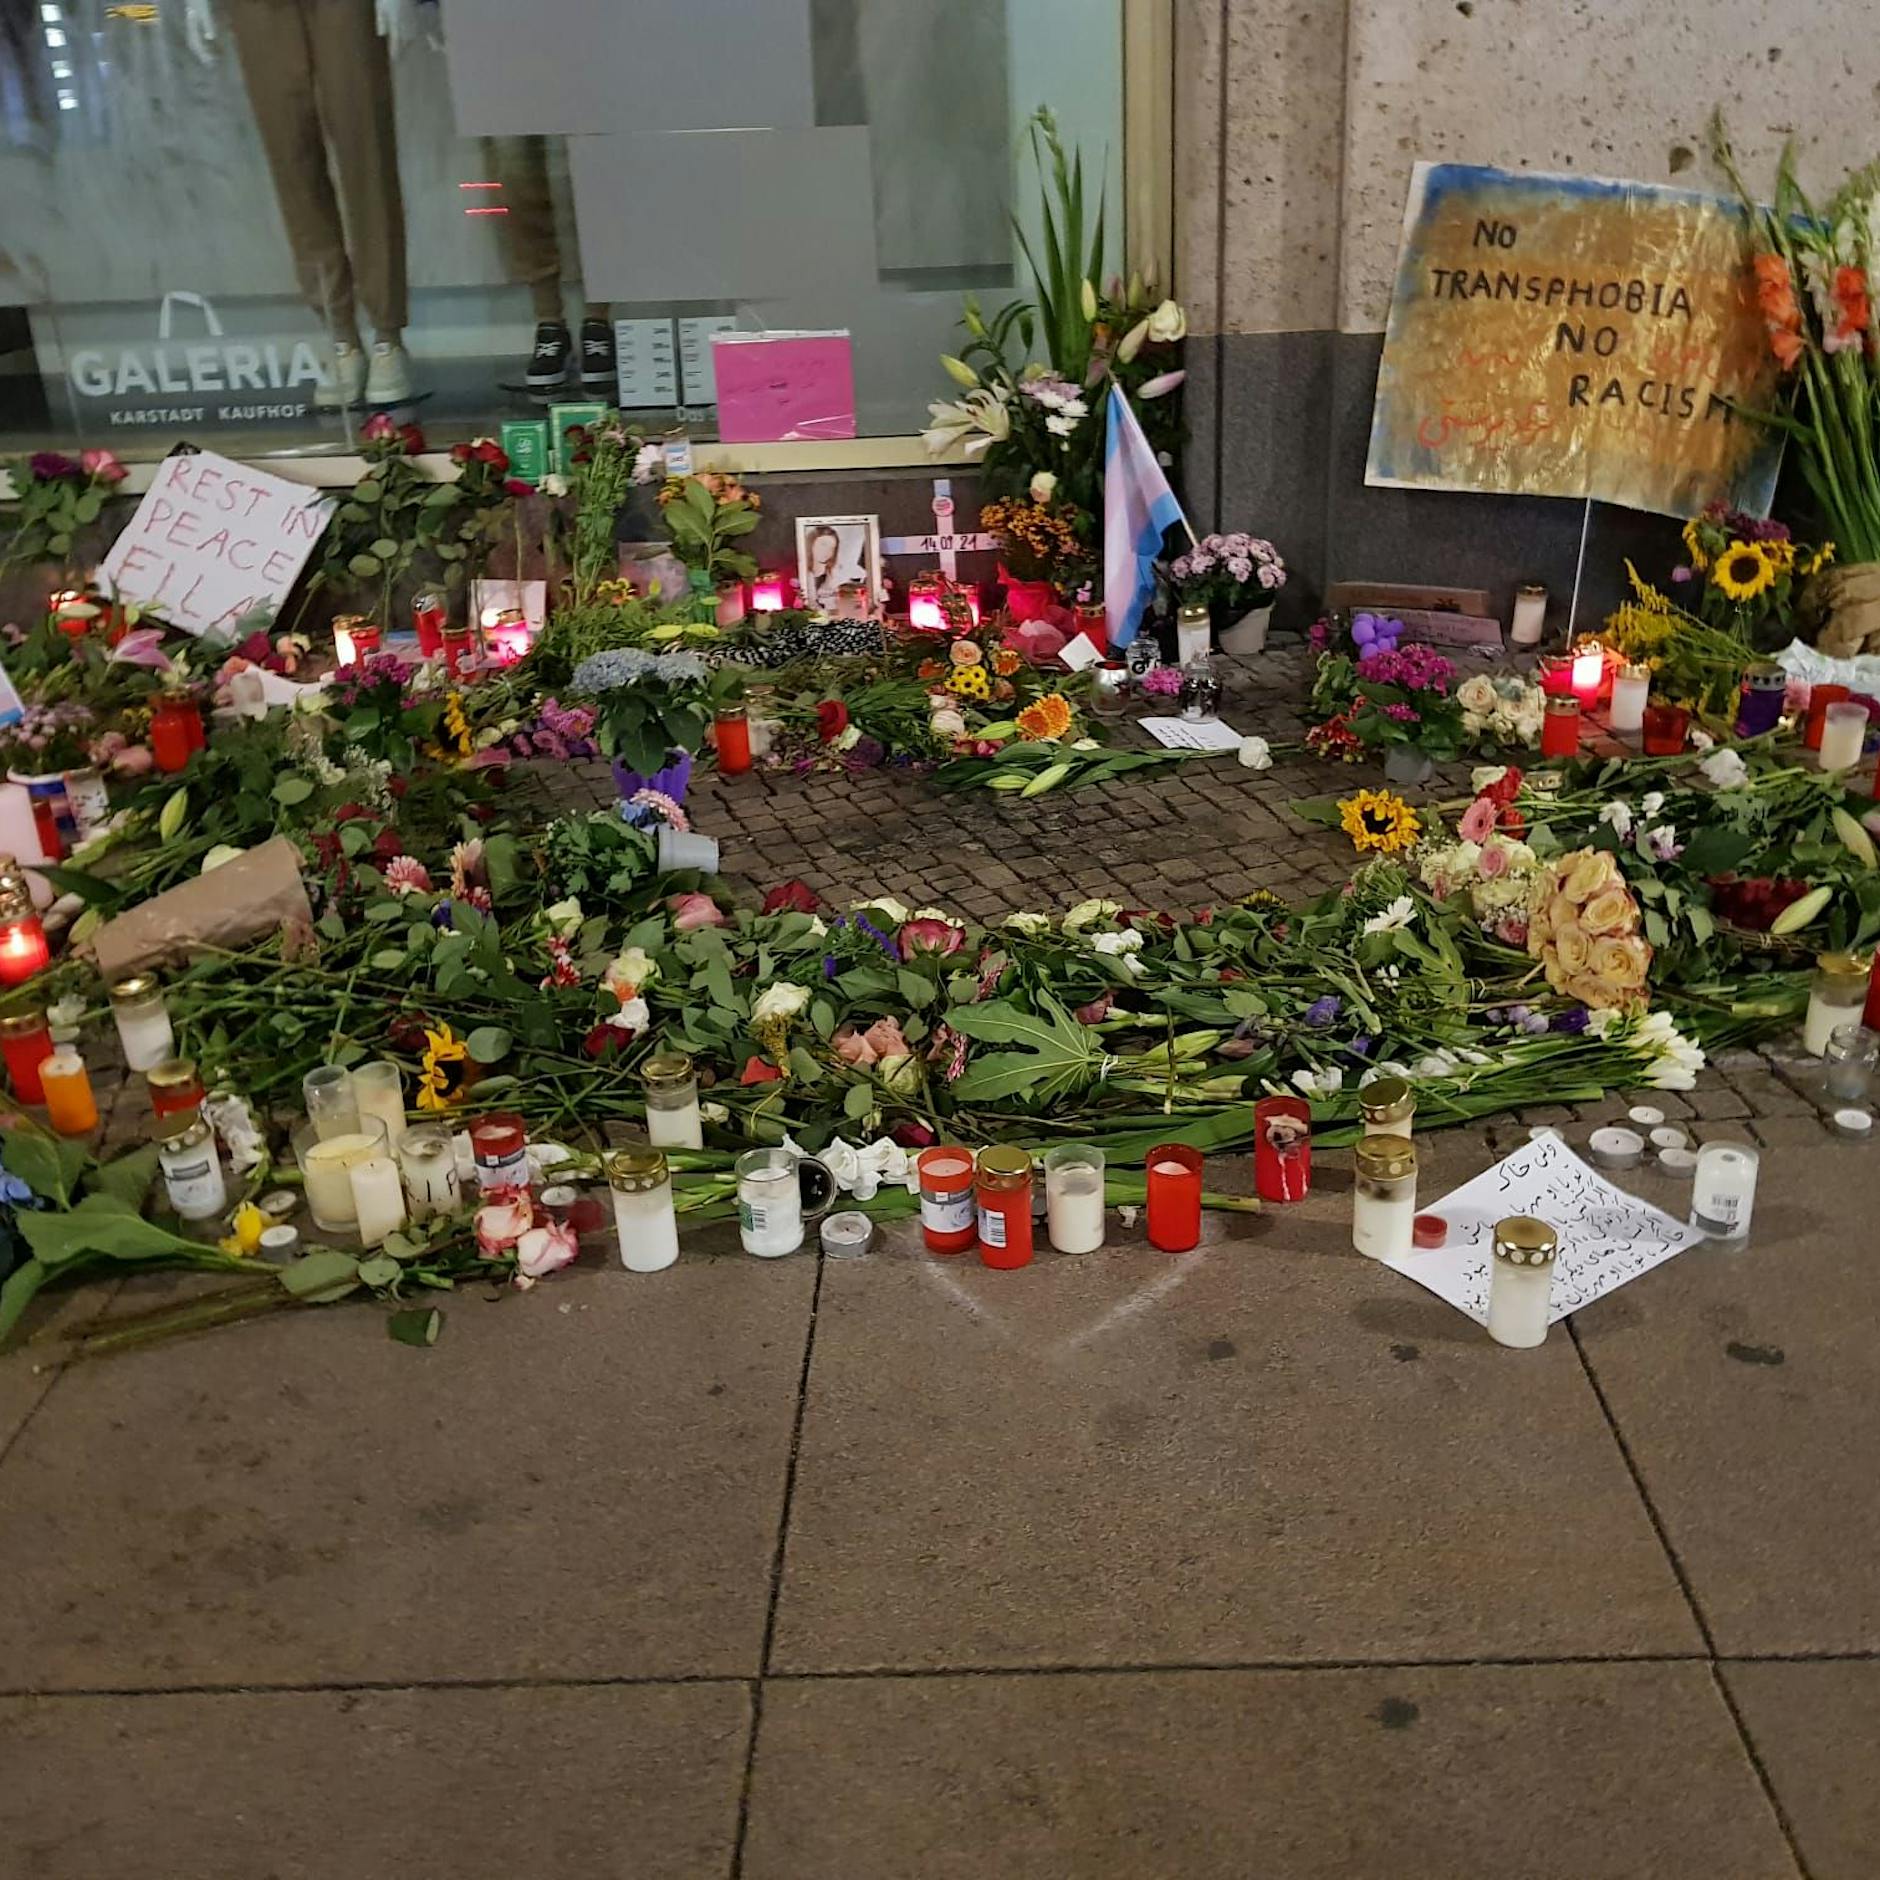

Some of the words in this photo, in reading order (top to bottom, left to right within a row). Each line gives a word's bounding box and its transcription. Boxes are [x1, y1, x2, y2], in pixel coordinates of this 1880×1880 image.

[1431, 269, 1693, 320] TRANSPHOBIA
[1555, 322, 1618, 357] NO
[71, 342, 332, 396] GALERIA
[110, 407, 204, 425] KARSTADT
[218, 404, 306, 421] KAUFHOF
[1569, 374, 1736, 425] RACISM
[167, 457, 272, 517] REST
[281, 506, 320, 538] IN
[144, 498, 294, 584] PEACE
